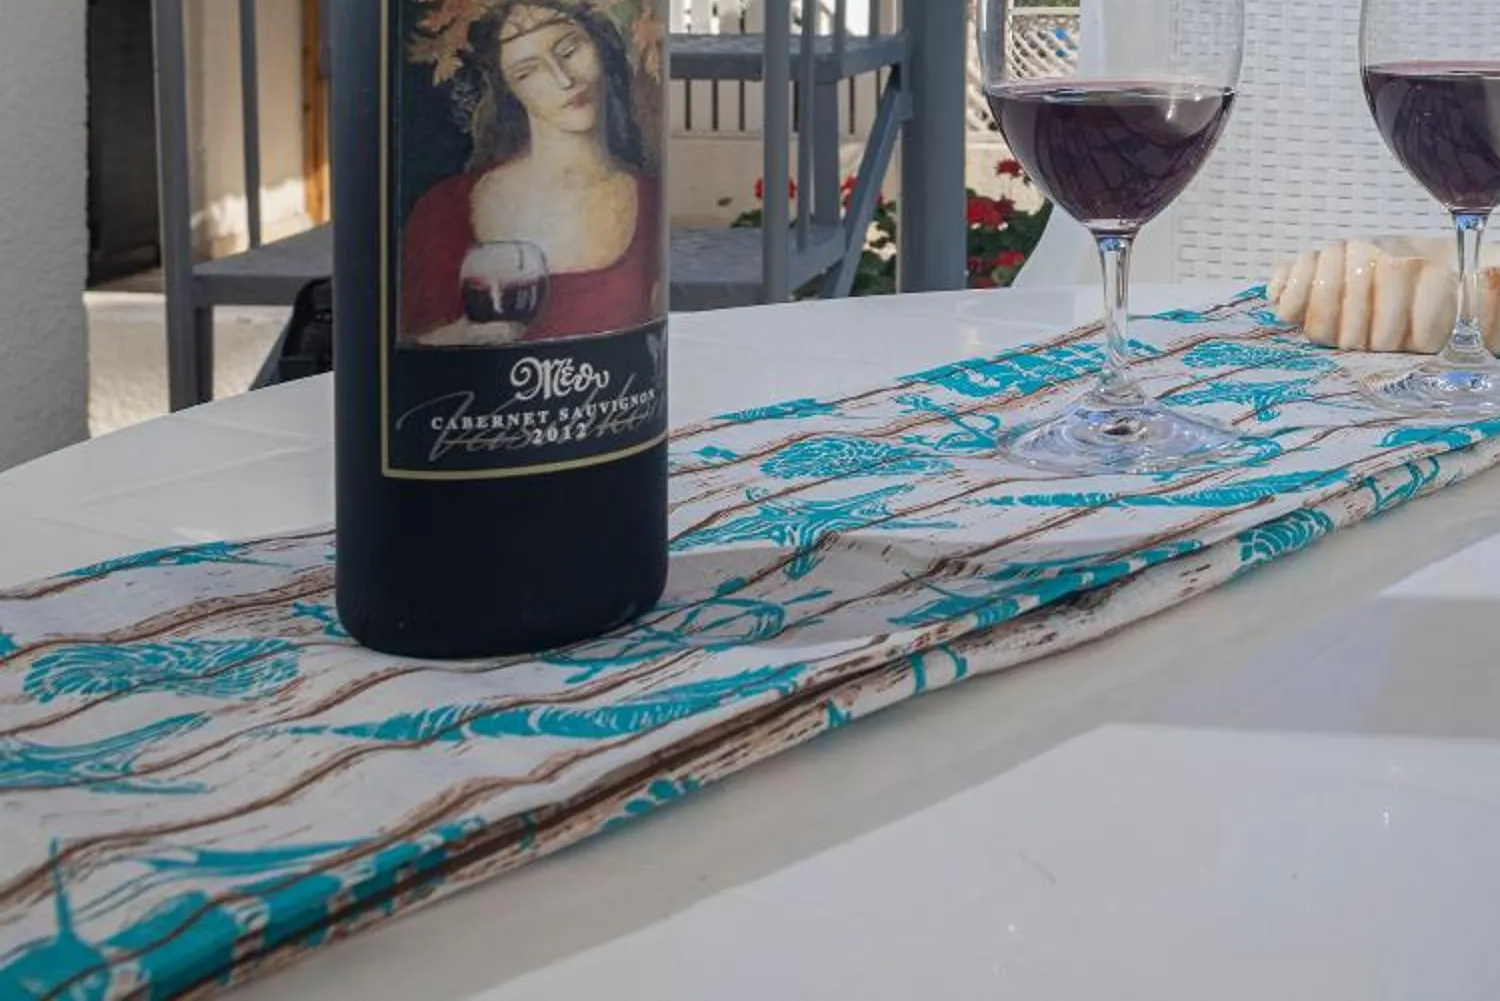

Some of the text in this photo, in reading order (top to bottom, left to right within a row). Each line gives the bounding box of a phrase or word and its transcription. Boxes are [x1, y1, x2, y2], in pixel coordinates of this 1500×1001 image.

[431, 388, 656, 431] CABERNET SAUVIGNON
[532, 422, 587, 445] 2012
